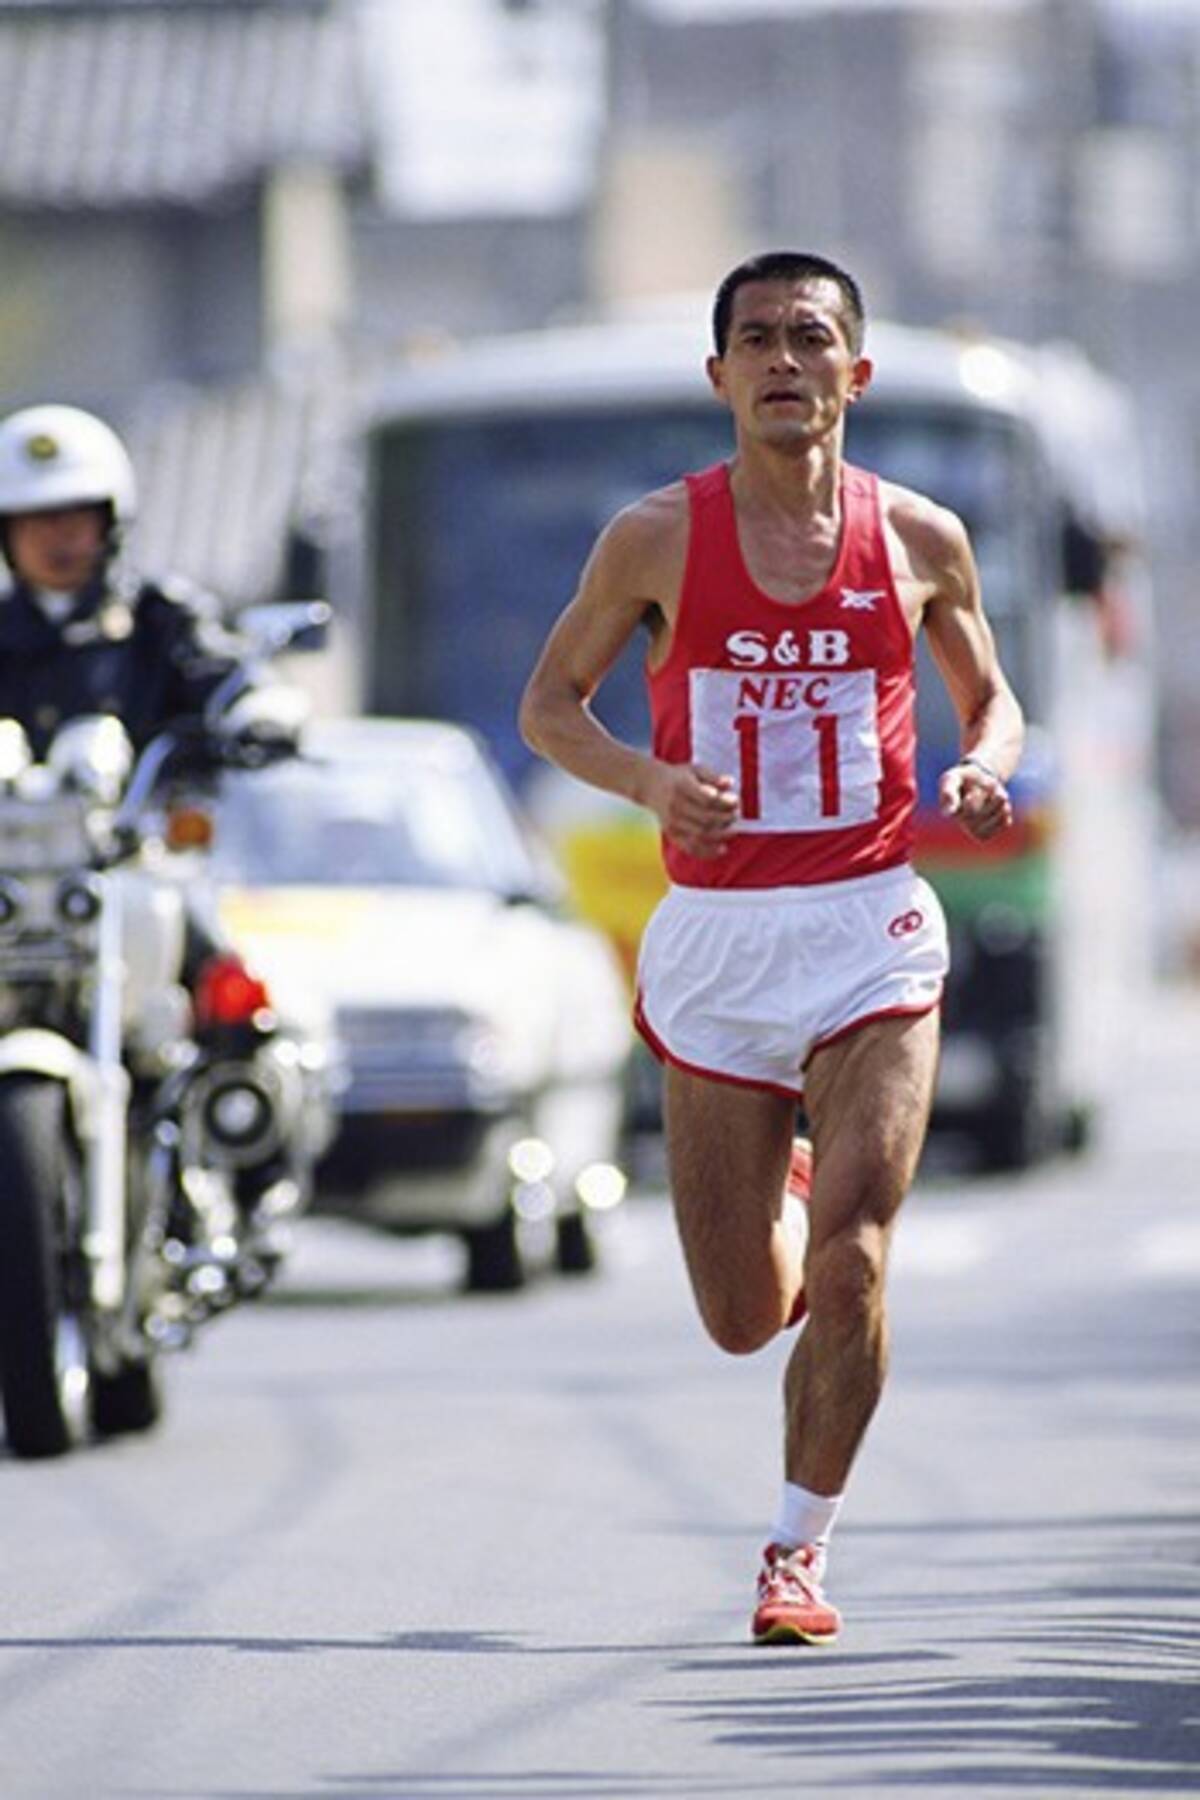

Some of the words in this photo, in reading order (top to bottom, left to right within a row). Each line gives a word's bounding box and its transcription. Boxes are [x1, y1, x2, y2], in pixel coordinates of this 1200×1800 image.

[726, 630, 849, 666] S&B
[737, 678, 830, 711] NEC
[733, 714, 840, 820] 11
